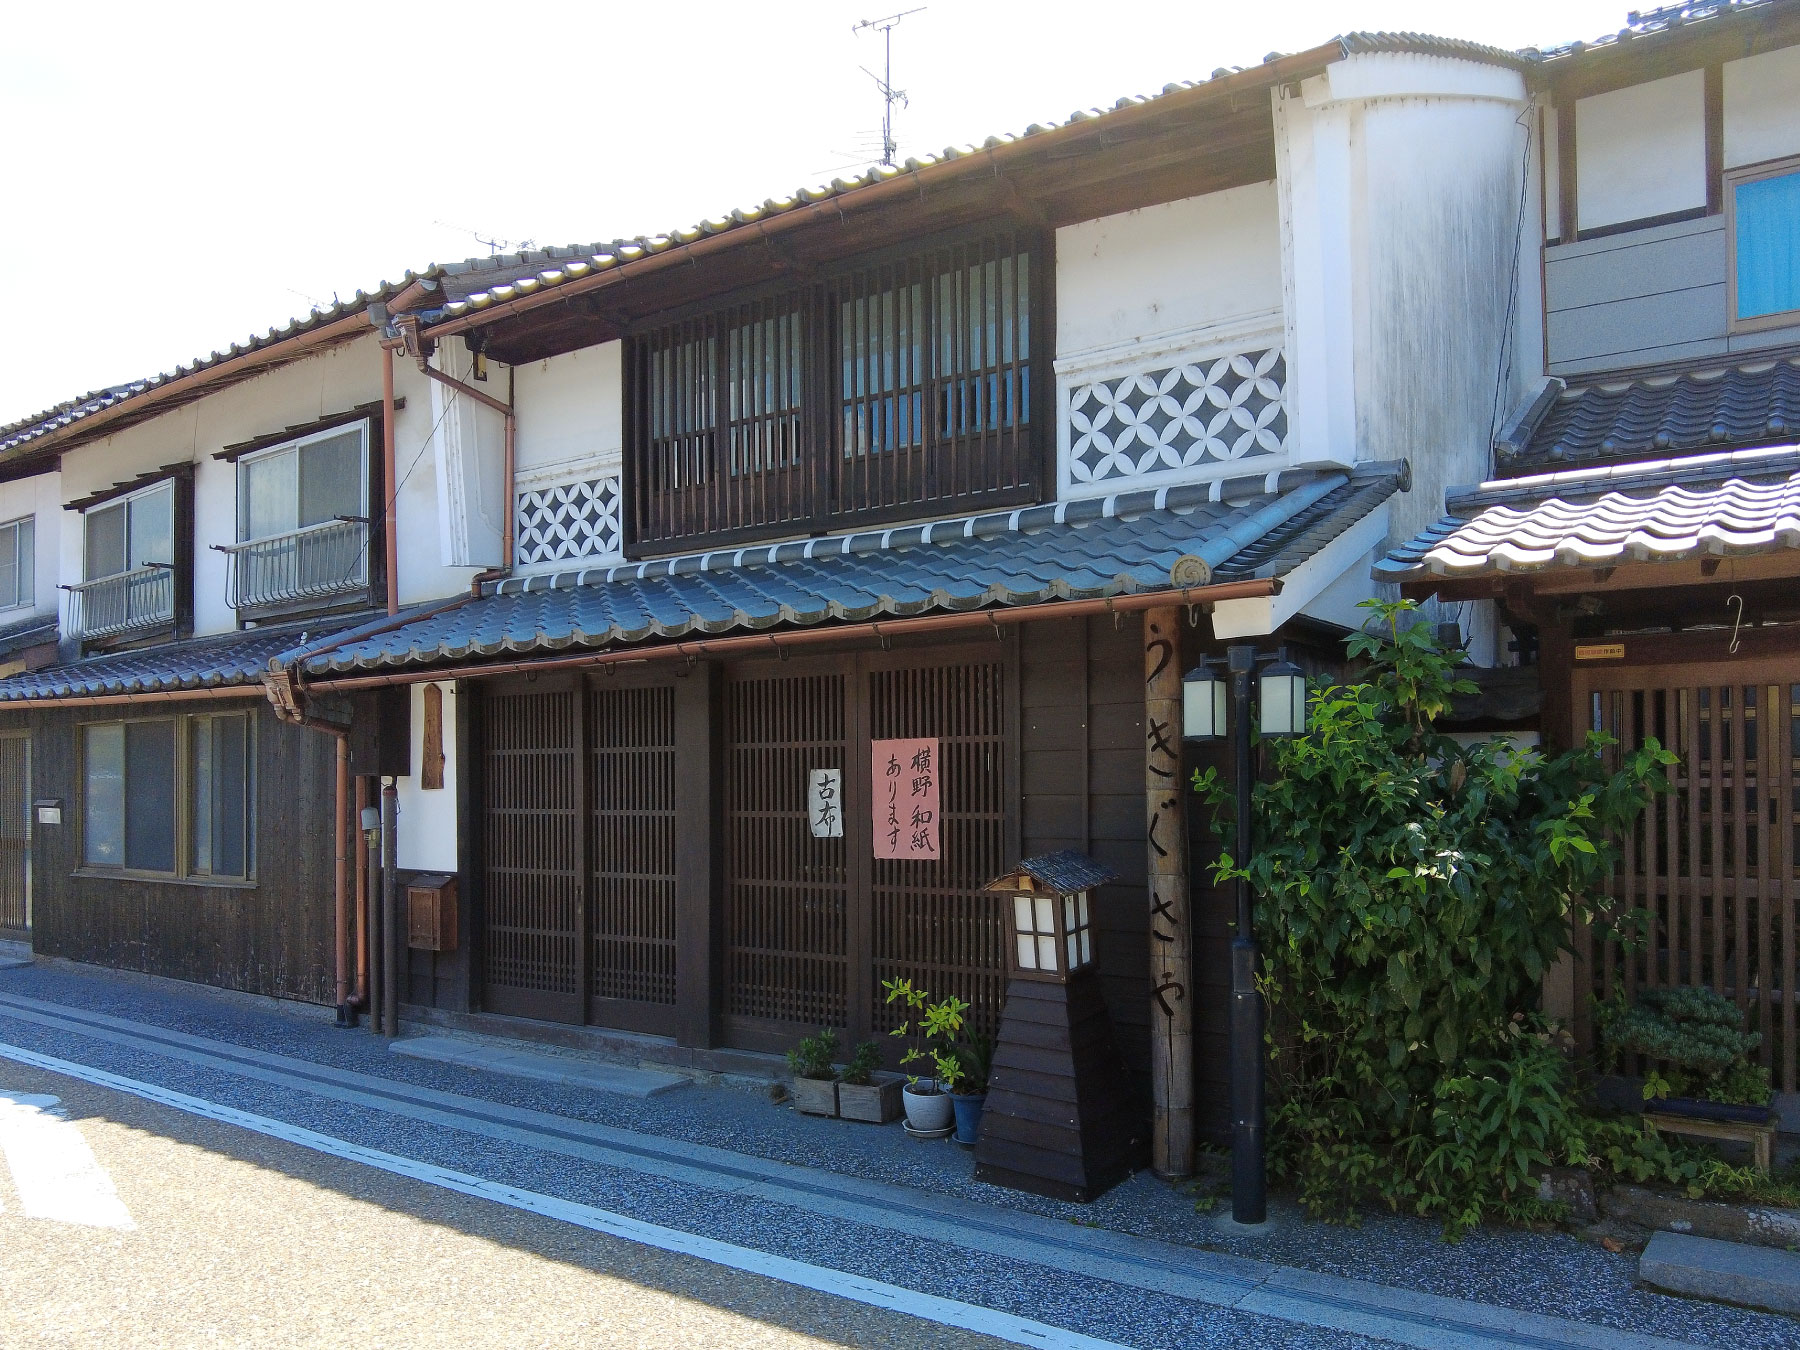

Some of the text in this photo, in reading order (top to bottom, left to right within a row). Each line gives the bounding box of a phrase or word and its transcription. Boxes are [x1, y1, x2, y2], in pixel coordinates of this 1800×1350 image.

[815, 773, 836, 837] 古布
[886, 753, 902, 853] あります
[1146, 623, 1184, 1017] うきぐさや
